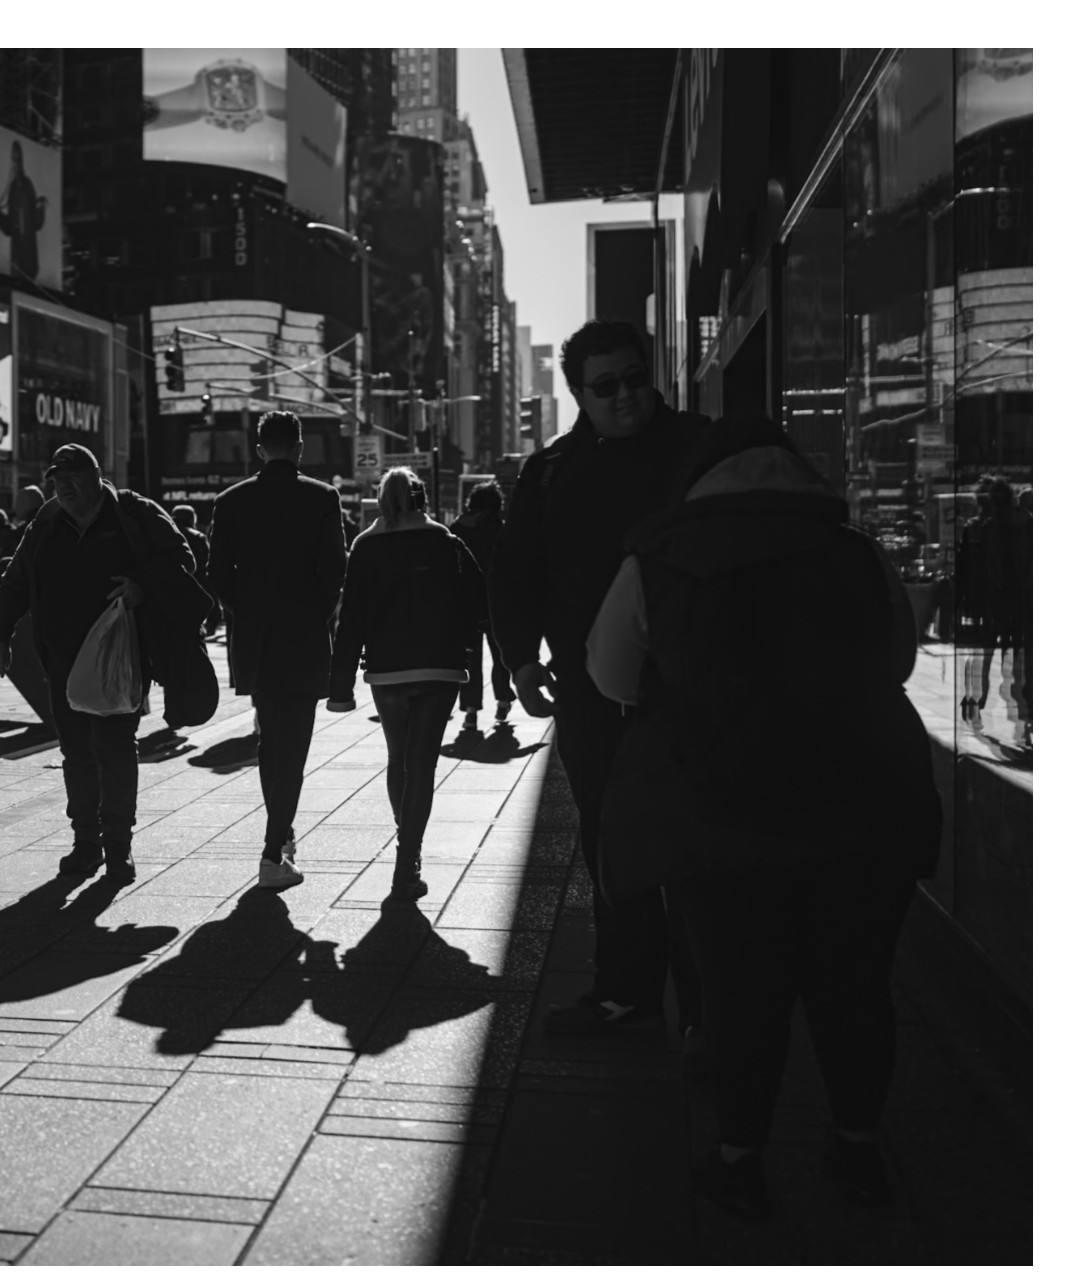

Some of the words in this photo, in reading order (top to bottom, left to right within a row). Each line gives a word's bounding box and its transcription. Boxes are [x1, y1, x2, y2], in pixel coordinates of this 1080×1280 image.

[35, 392, 64, 427] OLD
[65, 399, 101, 433] NAVY
[356, 453, 378, 467] 25
